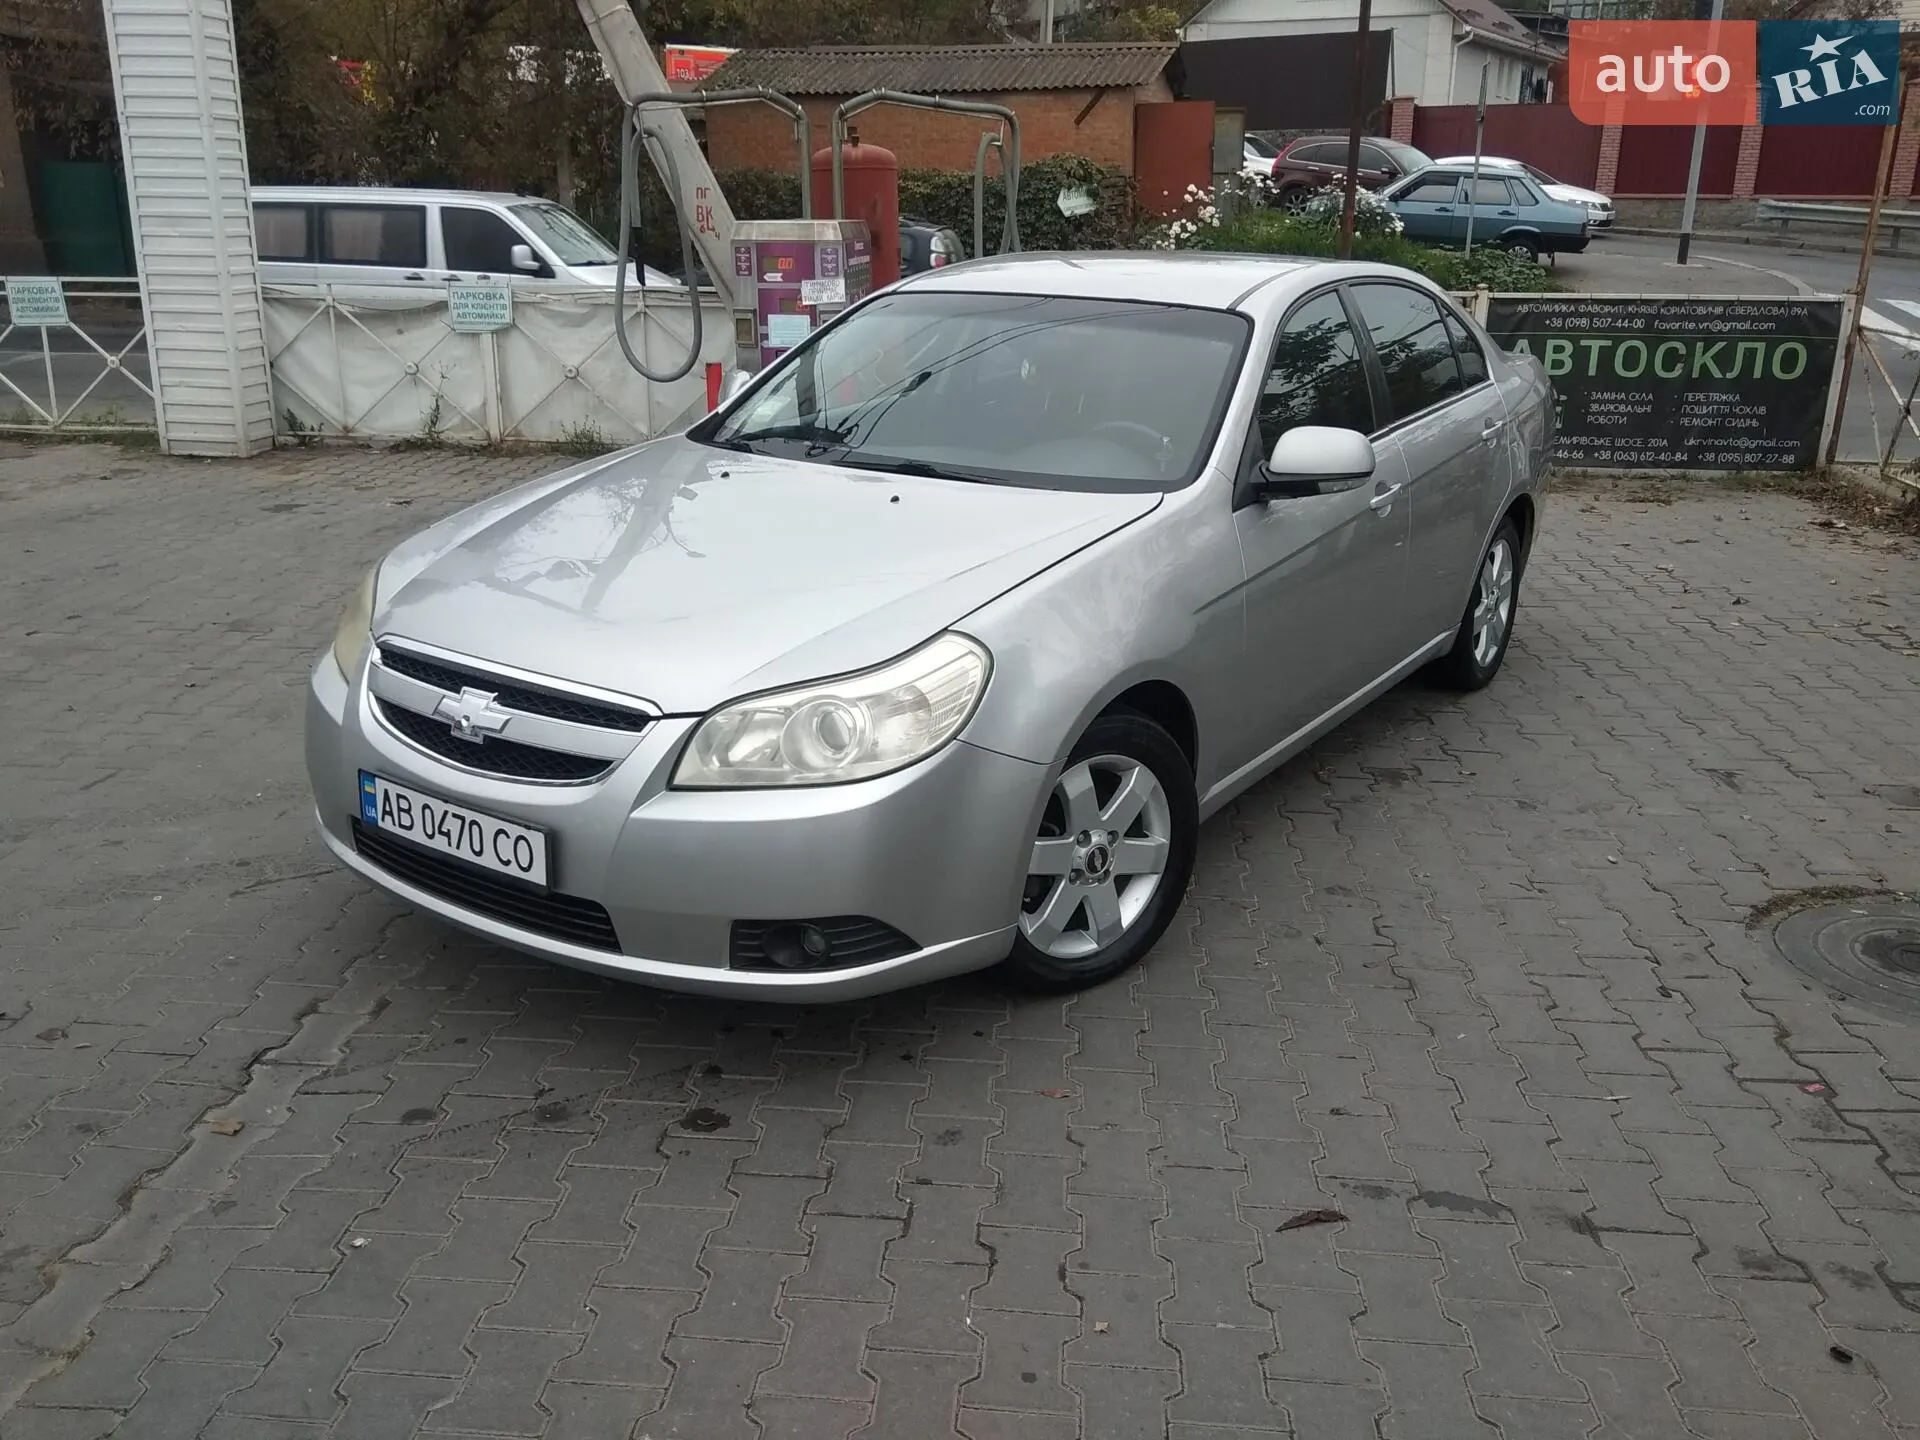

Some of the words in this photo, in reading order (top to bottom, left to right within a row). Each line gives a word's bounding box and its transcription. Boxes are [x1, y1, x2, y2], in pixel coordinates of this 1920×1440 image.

[11, 286, 57, 294] ПАРКОВКА
[452, 291, 505, 301] ПАРКОВКА
[453, 302, 469, 310] ДЛЯ
[471, 302, 507, 311] КЛІЄНТІВ
[1516, 303, 1575, 313] АВТОМИЙКА
[1578, 304, 1627, 314] ФАВОРИТ,
[1628, 305, 1658, 315] КНЯЗІВ
[1660, 306, 1724, 316] КОРІАТОВИЧІВ
[1725, 306, 1789, 318] (СВЕРДЛОВА)
[456, 311, 506, 320] АВТОМИЙКИ
[1544, 318, 1563, 327] +38
[1565, 317, 1590, 330] (098)
[1592, 318, 1645, 329] 507-44-00
[1654, 319, 1776, 332] favorite.vn@gmail.com
[1590, 391, 1626, 401] ЗАМІНА
[1628, 392, 1654, 401] СКЛА
[1683, 392, 1740, 402] ПЕРЕТЯЖКА
[1588, 403, 1652, 413] ЗВАРЮВАЛЬНІ
[1681, 404, 1730, 414] ПОШИТТЯ
[1732, 405, 1767, 415] ЧОХЛІВ
[1586, 415, 1627, 424] РОБОТИ
[1680, 417, 1722, 427] РЕМОНТ
[1725, 418, 1760, 428] СИДІНЬ
[1553, 435, 1612, 447] ЕМИРІВСЬКЕ
[1614, 437, 1645, 447] ШОСЕ,
[1647, 438, 1669, 448] 201А
[1684, 436, 1800, 449] ukrvinavto@gmail.com
[1593, 450, 1611, 460] +38
[1613, 450, 1638, 463] (063)
[1640, 451, 1688, 462] 612-40-84
[1697, 452, 1716, 462] +38
[1718, 452, 1743, 465] (095)
[1744, 453, 1796, 464] 807-27-88
[365, 806, 377, 819] UA
[380, 788, 415, 832] AB
[421, 803, 484, 857] 0470
[492, 828, 534, 873] CO
